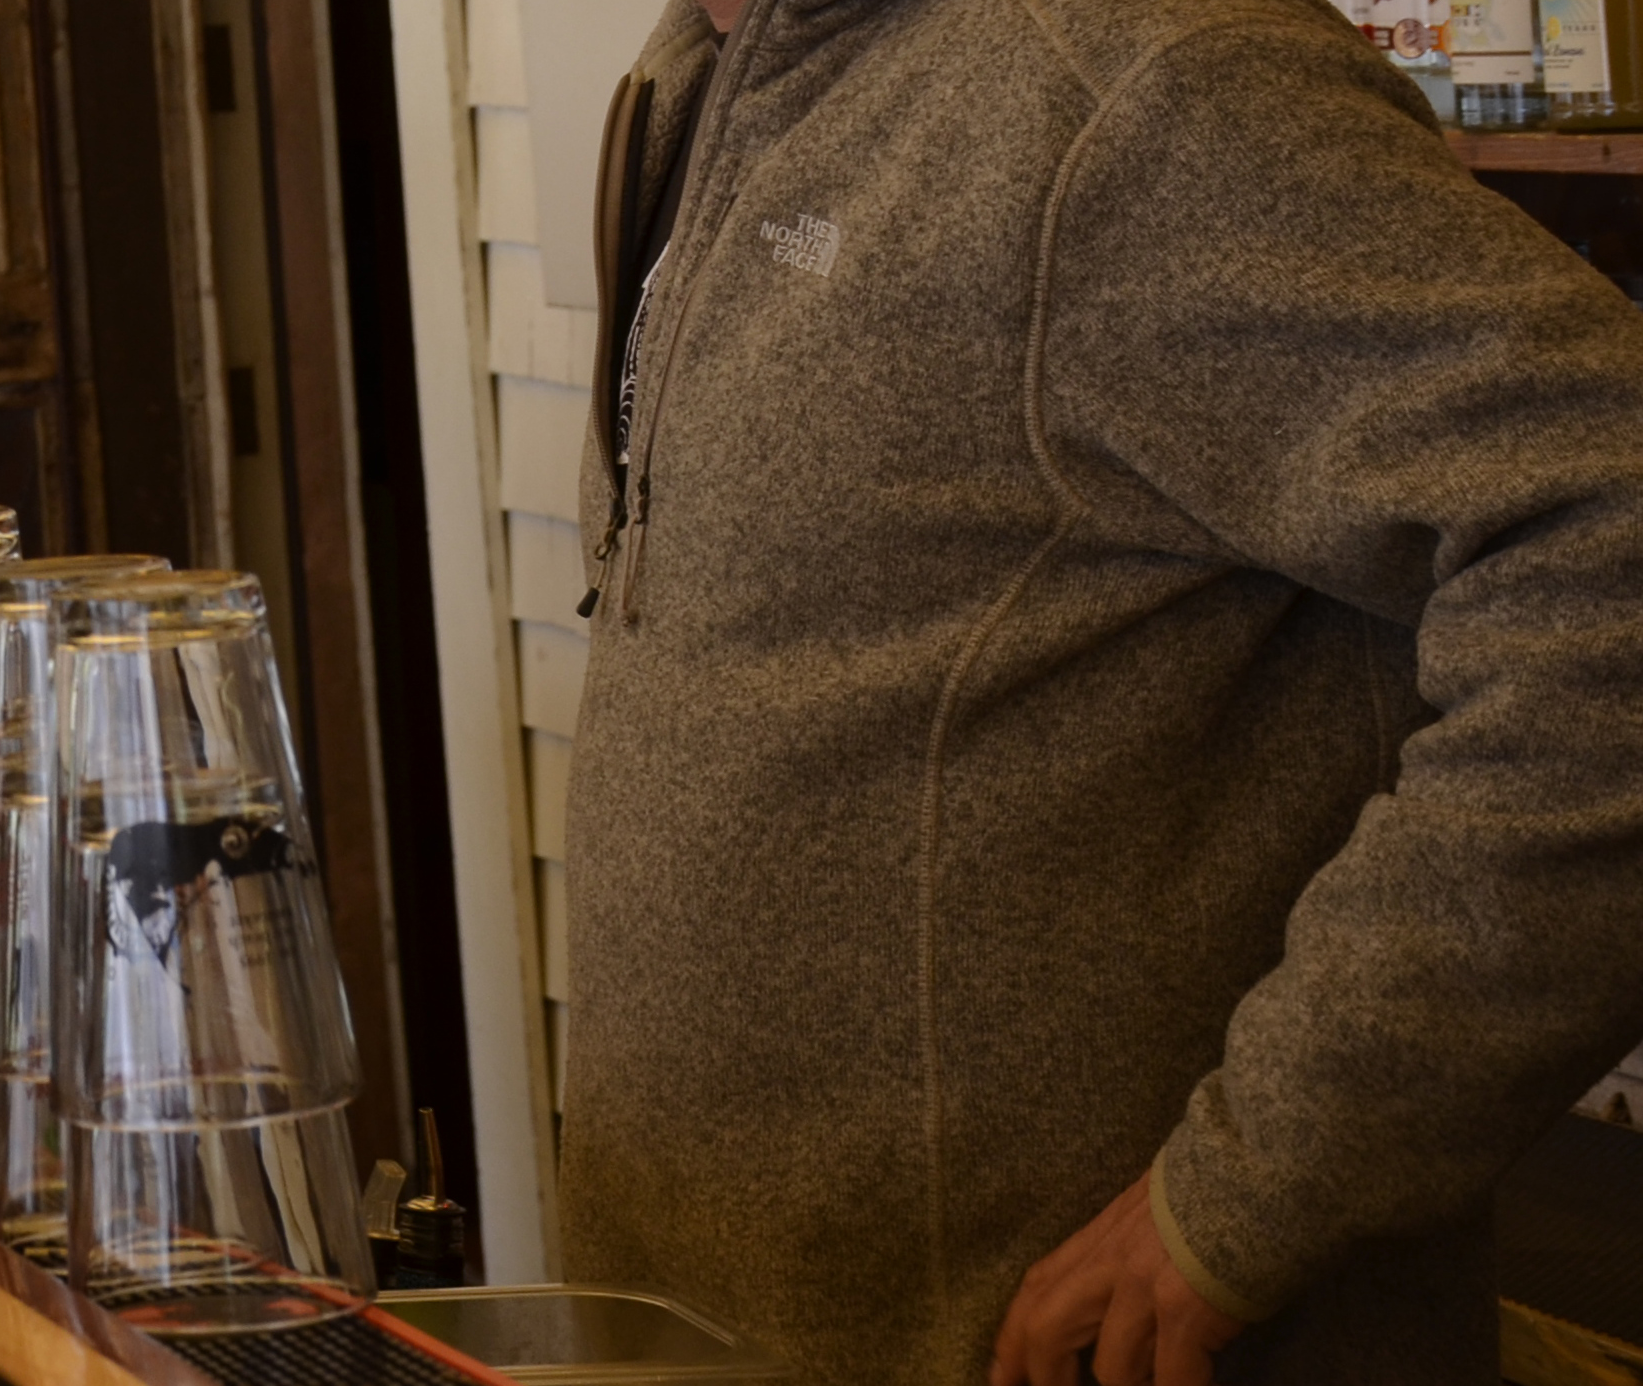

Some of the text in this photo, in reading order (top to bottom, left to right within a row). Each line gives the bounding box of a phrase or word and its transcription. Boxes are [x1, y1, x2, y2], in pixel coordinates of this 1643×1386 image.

[759, 220, 828, 255] NORTH
[796, 213, 830, 239] THE
[772, 244, 817, 272] FACE
